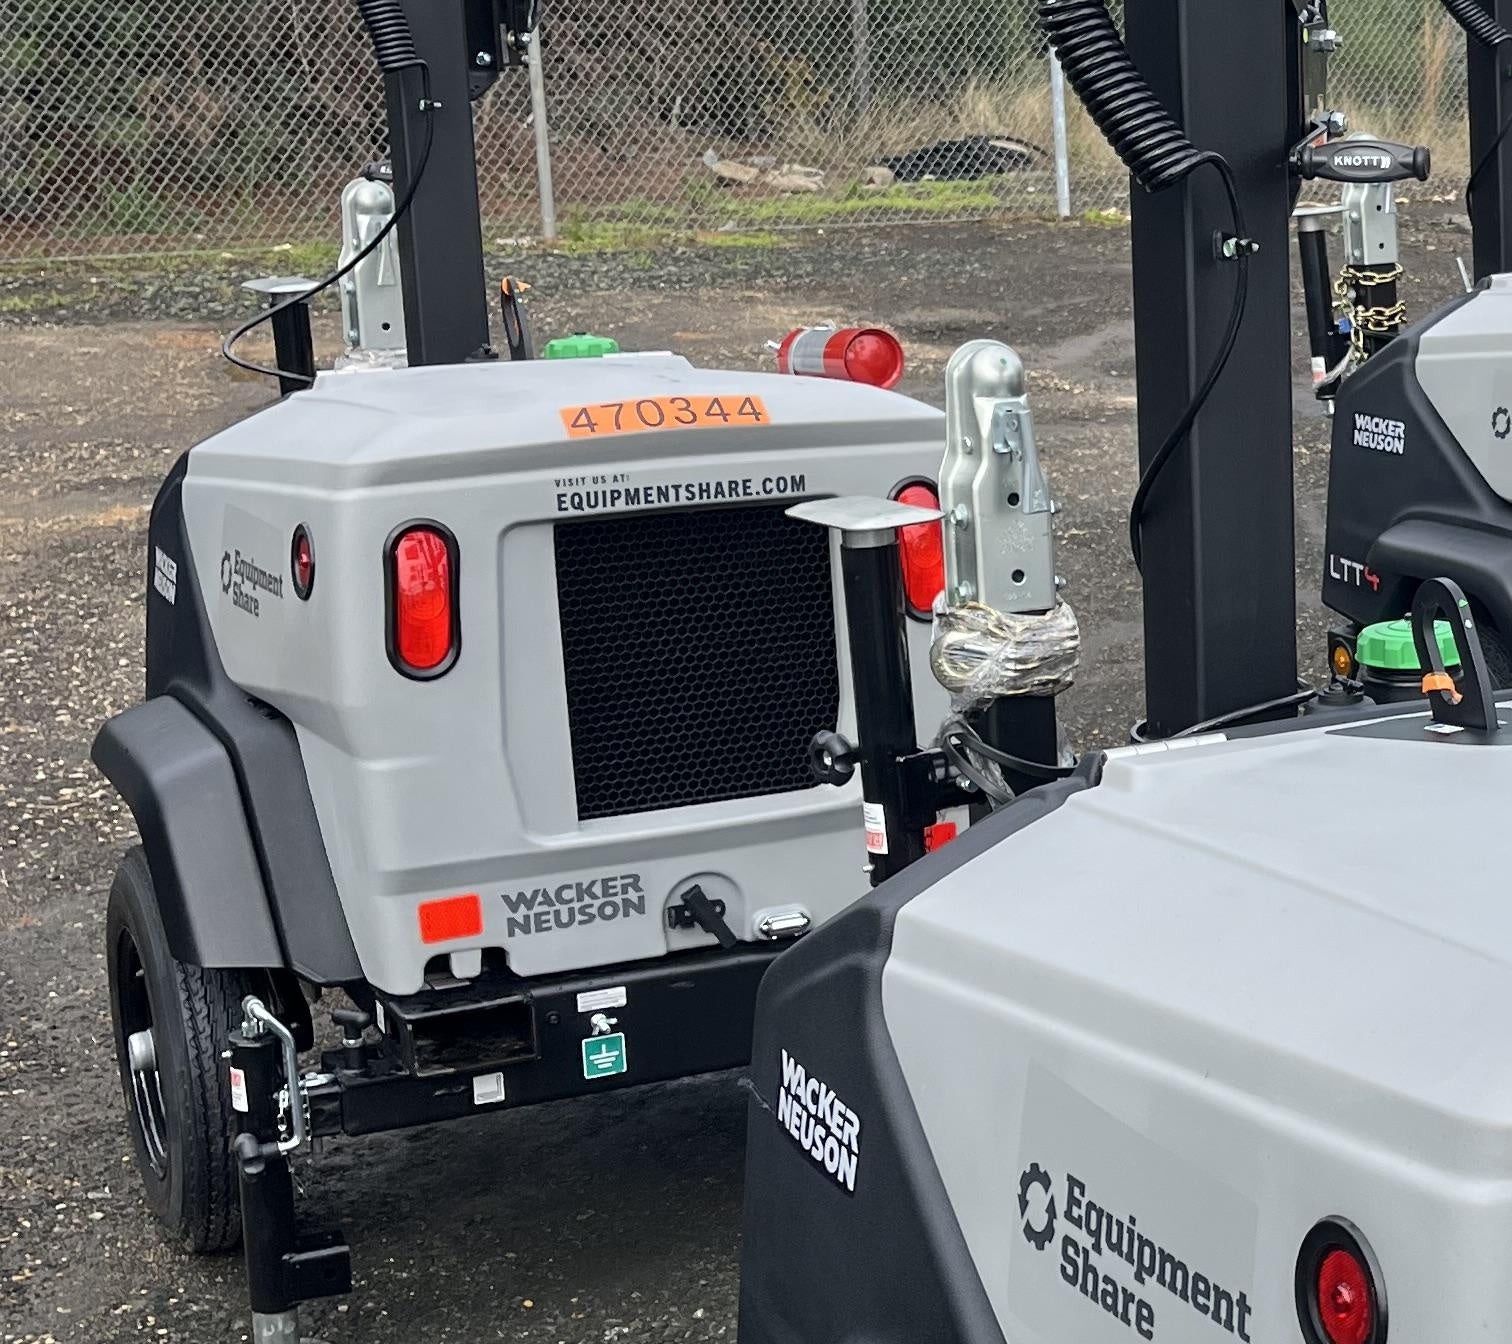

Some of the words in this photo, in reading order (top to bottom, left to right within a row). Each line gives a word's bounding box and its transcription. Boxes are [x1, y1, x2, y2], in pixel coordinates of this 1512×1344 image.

[1334, 156, 1379, 166] KNOTT
[571, 397, 762, 432] 470344
[1354, 413, 1405, 438] WACKER
[1353, 430, 1404, 454] NEUSON
[554, 477, 586, 488] VISIT
[592, 475, 606, 485] US
[557, 474, 806, 512] EQUIPMENTSHARE.COM
[234, 549, 283, 599] Equipment
[1330, 554, 1380, 591] LTT4
[232, 581, 259, 616] Share
[500, 873, 644, 914] WACKER
[506, 895, 646, 938] NEUSON
[781, 1048, 860, 1154] WACKER
[778, 1086, 858, 1191] NEUSON
[1064, 1173, 1252, 1344] Equipment
[1060, 1234, 1154, 1341] Share
